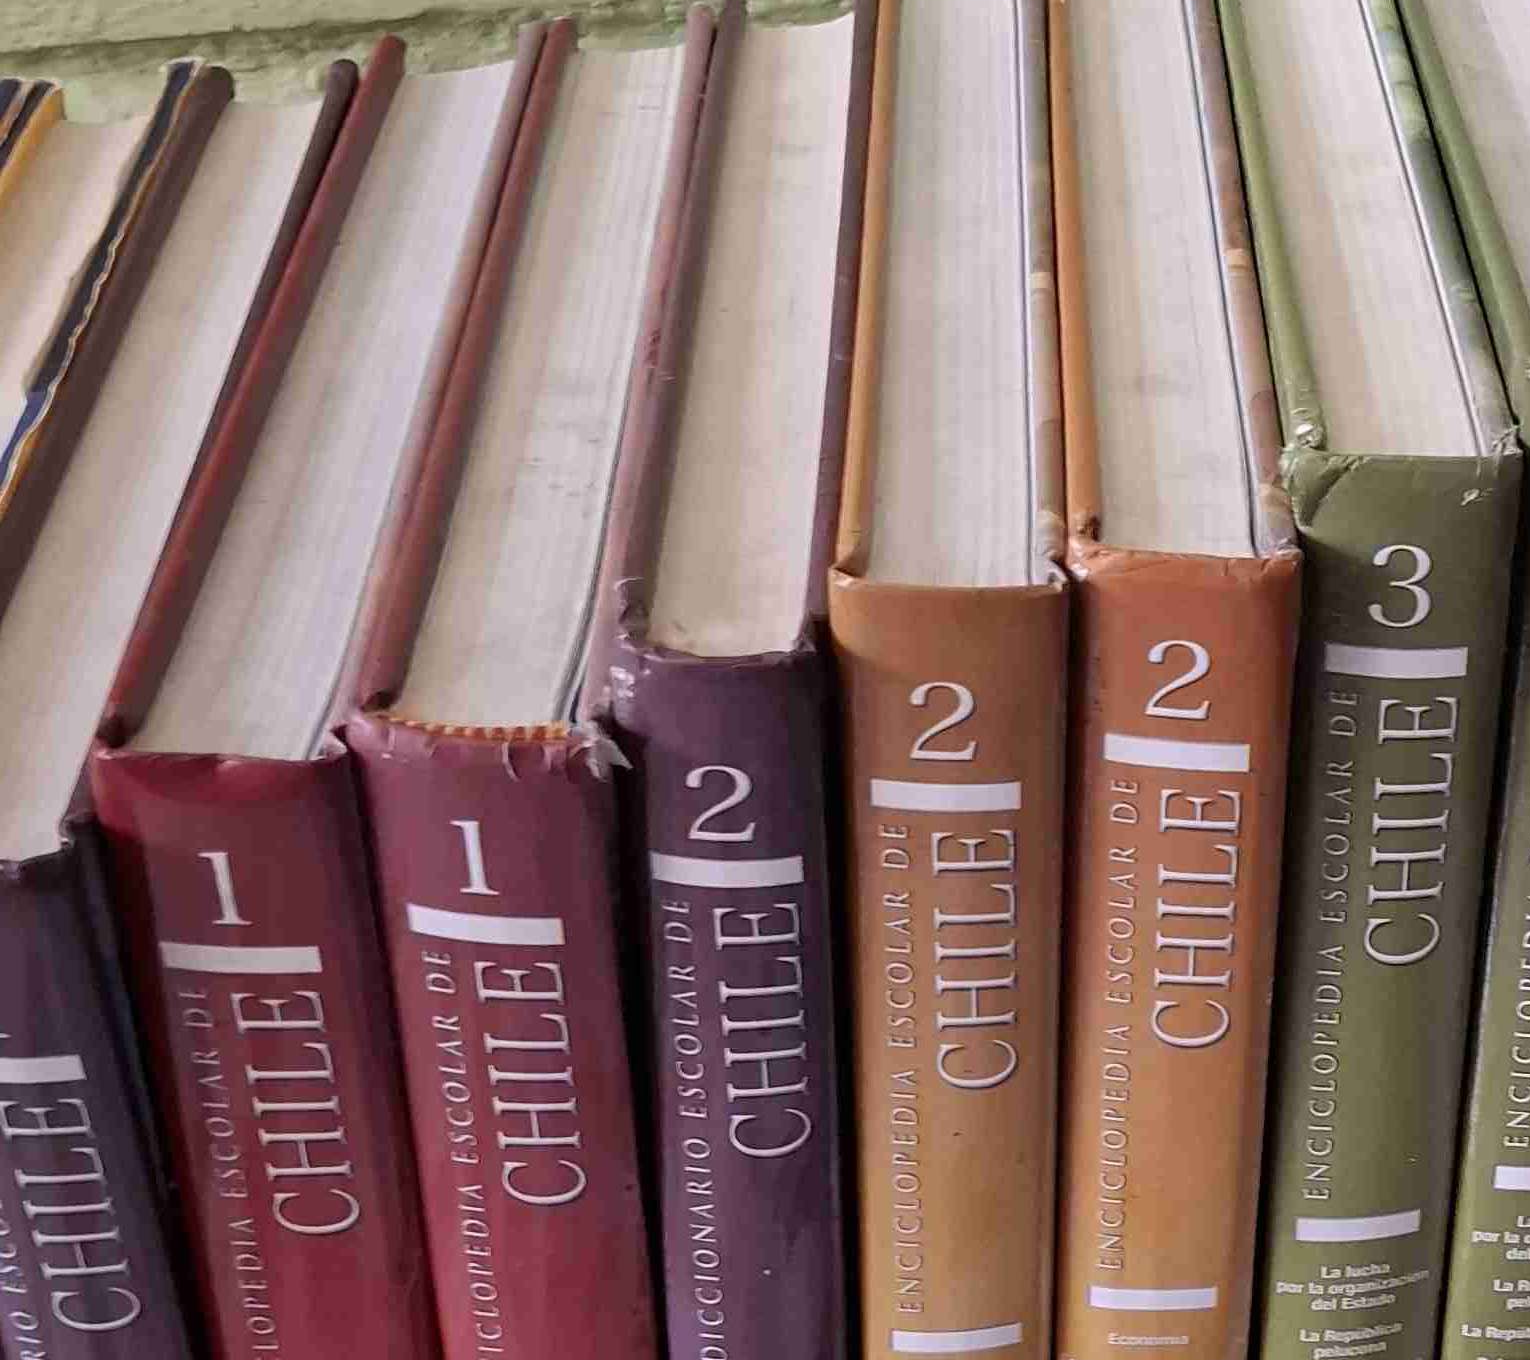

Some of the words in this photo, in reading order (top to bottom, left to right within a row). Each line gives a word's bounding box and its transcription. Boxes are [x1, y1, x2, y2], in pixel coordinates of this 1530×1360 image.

[1368, 545, 1432, 628] 3
[1144, 640, 1211, 720] 2
[1328, 691, 1358, 737] DE
[909, 682, 977, 761] 2
[685, 765, 755, 842] 2
[1110, 779, 1139, 825] DE
[1320, 760, 1353, 923] ESCOLAR
[1364, 696, 1458, 965] CHILE
[449, 820, 500, 895] 1
[879, 824, 910, 870] DE
[197, 851, 253, 925] 1
[661, 900, 694, 944] DE
[1104, 846, 1137, 1005] ESCOLAR
[1152, 789, 1241, 1048] CHILE
[421, 951, 456, 994] DE
[883, 890, 917, 1048] ESCOLAR
[931, 829, 1018, 1089] CHILE
[178, 987, 213, 1028] DE
[667, 964, 709, 1119] ESCOLAR
[712, 903, 812, 1157] CHILE
[230, 990, 360, 1235] CHILE
[432, 1015, 481, 1165] ESCOLAR
[473, 961, 587, 1205] CHILE
[1303, 944, 1344, 1200] ENCICLOPEDIA
[191, 1050, 249, 1198] ESCOLAR
[1096, 1024, 1132, 1271] ENCICLOPEDIA
[0, 1098, 142, 1331] CHILE
[890, 1070, 924, 1314] ENCICLOPEDIA
[1320, 1265, 1341, 1279] La
[1471, 1230, 1500, 1244] por
[1503, 1231, 1520, 1244] la
[1310, 1298, 1337, 1311] del
[1340, 1294, 1396, 1311] Estado
[1493, 1279, 1514, 1292] La
[1299, 1328, 1320, 1342] La
[1460, 1323, 1482, 1338] La
